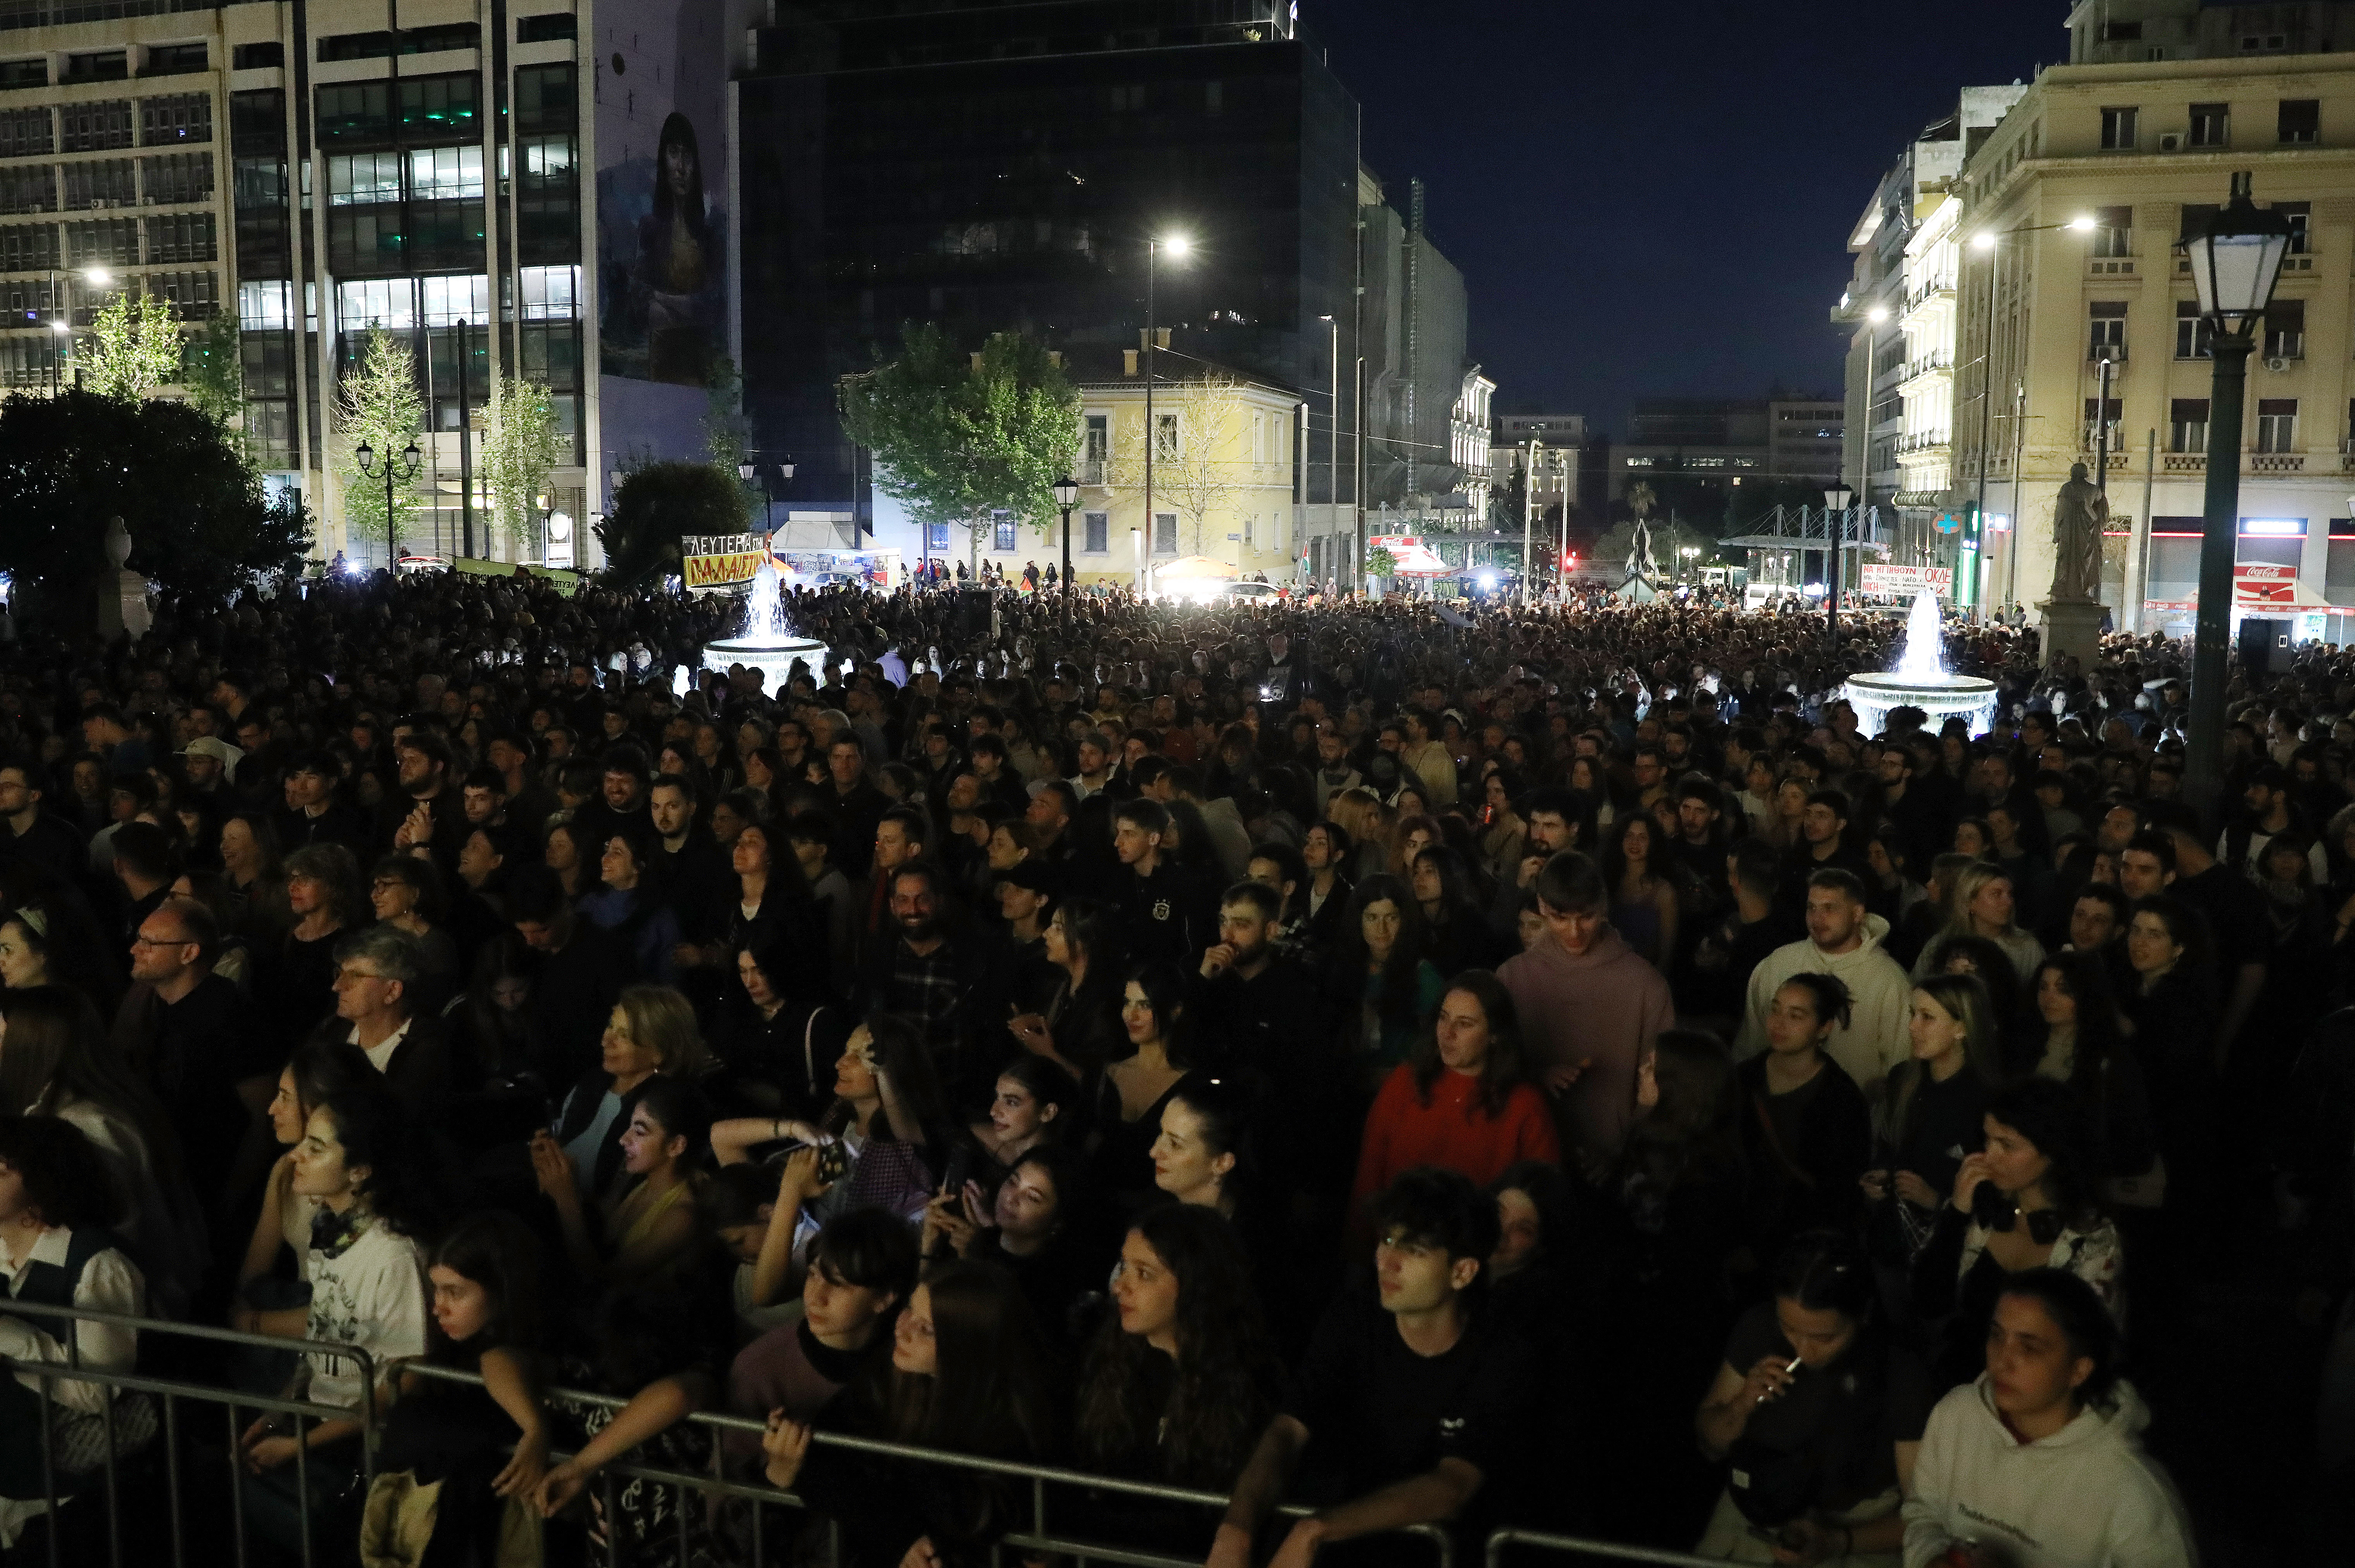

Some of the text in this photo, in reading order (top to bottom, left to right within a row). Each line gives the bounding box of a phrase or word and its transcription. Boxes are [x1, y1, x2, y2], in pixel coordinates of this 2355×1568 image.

[752, 537, 763, 550] ΣΤΗΝ
[1380, 538, 1404, 546] Coca-Cola
[1864, 566, 1916, 574] ΝΑ ΗΤΤΗΘΟΥΝ
[2247, 566, 2280, 577] Coca-Cola
[1925, 568, 1953, 583] ΟΚΔΕ
[1863, 582, 1879, 592] ΝΙΚΗ
